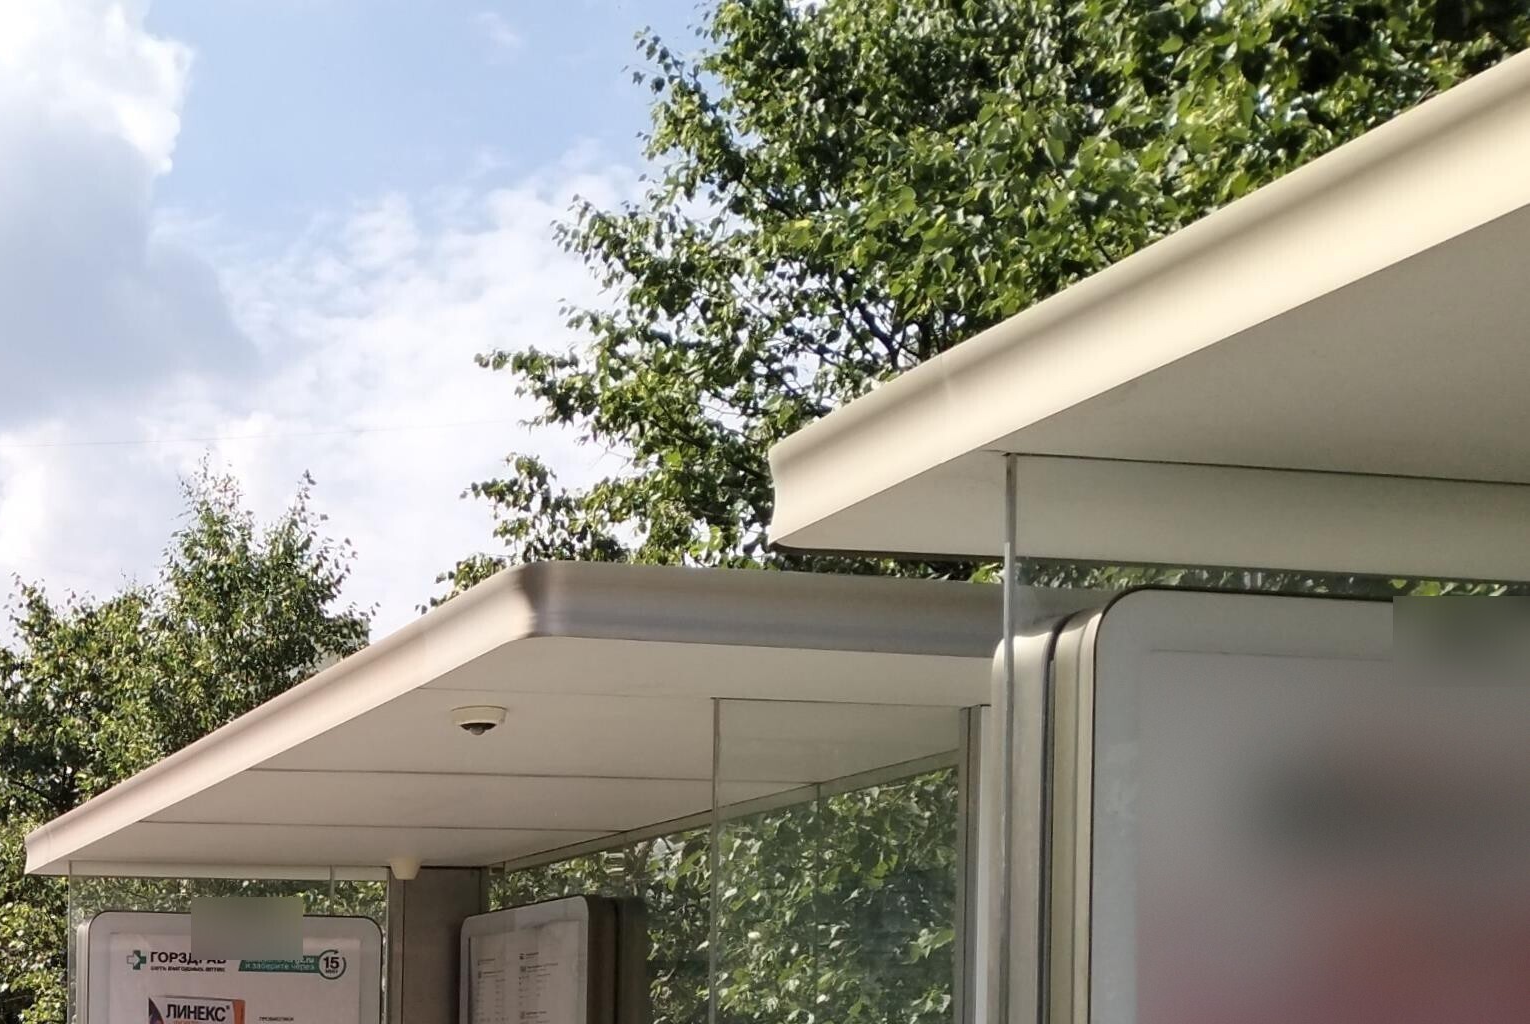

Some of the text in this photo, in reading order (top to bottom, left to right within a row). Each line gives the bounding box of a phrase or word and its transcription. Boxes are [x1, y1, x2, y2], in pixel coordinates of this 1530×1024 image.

[150, 951, 226, 964] ГОРЗД
[323, 956, 340, 969] 15
[166, 1004, 226, 1022] ЛИНЕКС
